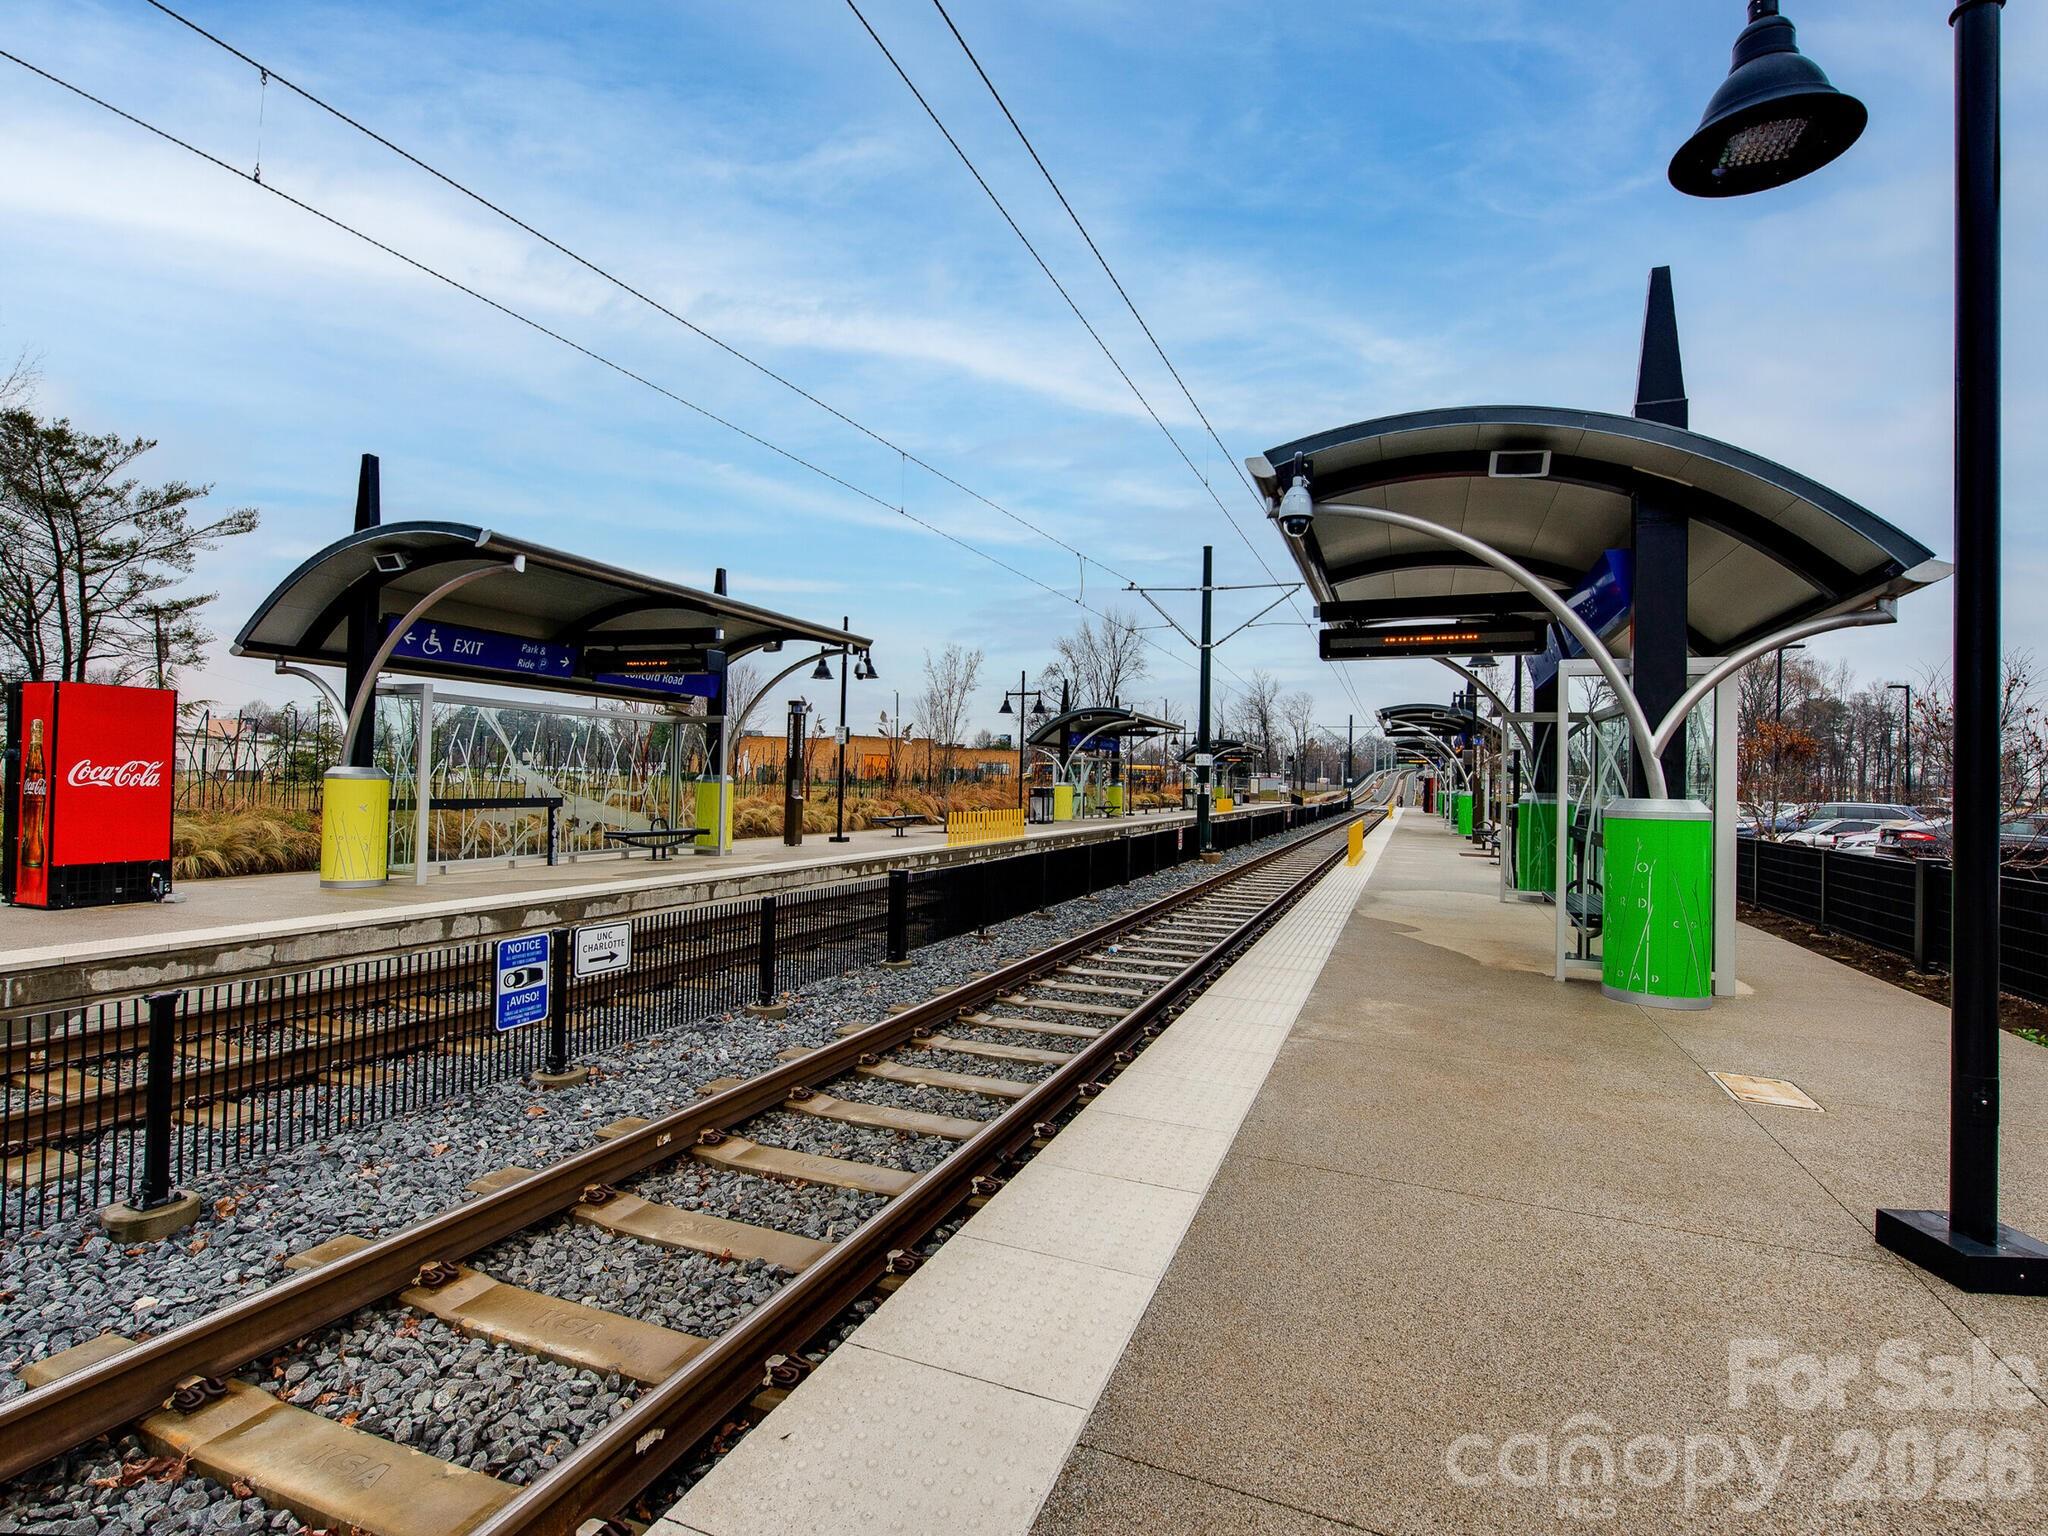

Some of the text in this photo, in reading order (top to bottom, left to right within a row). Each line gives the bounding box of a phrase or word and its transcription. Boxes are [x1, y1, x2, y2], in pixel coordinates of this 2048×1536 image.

[453, 638, 484, 656] EXIT
[521, 643, 546, 655] Park &
[517, 658, 535, 670] Ride
[662, 674, 685, 686] Road
[68, 759, 164, 788] Coca-Cola
[597, 930, 613, 941] UNC
[507, 939, 541, 955] NOTICE
[583, 938, 625, 953] CHARLOTTE
[506, 990, 540, 1011] ¡AVISO!
